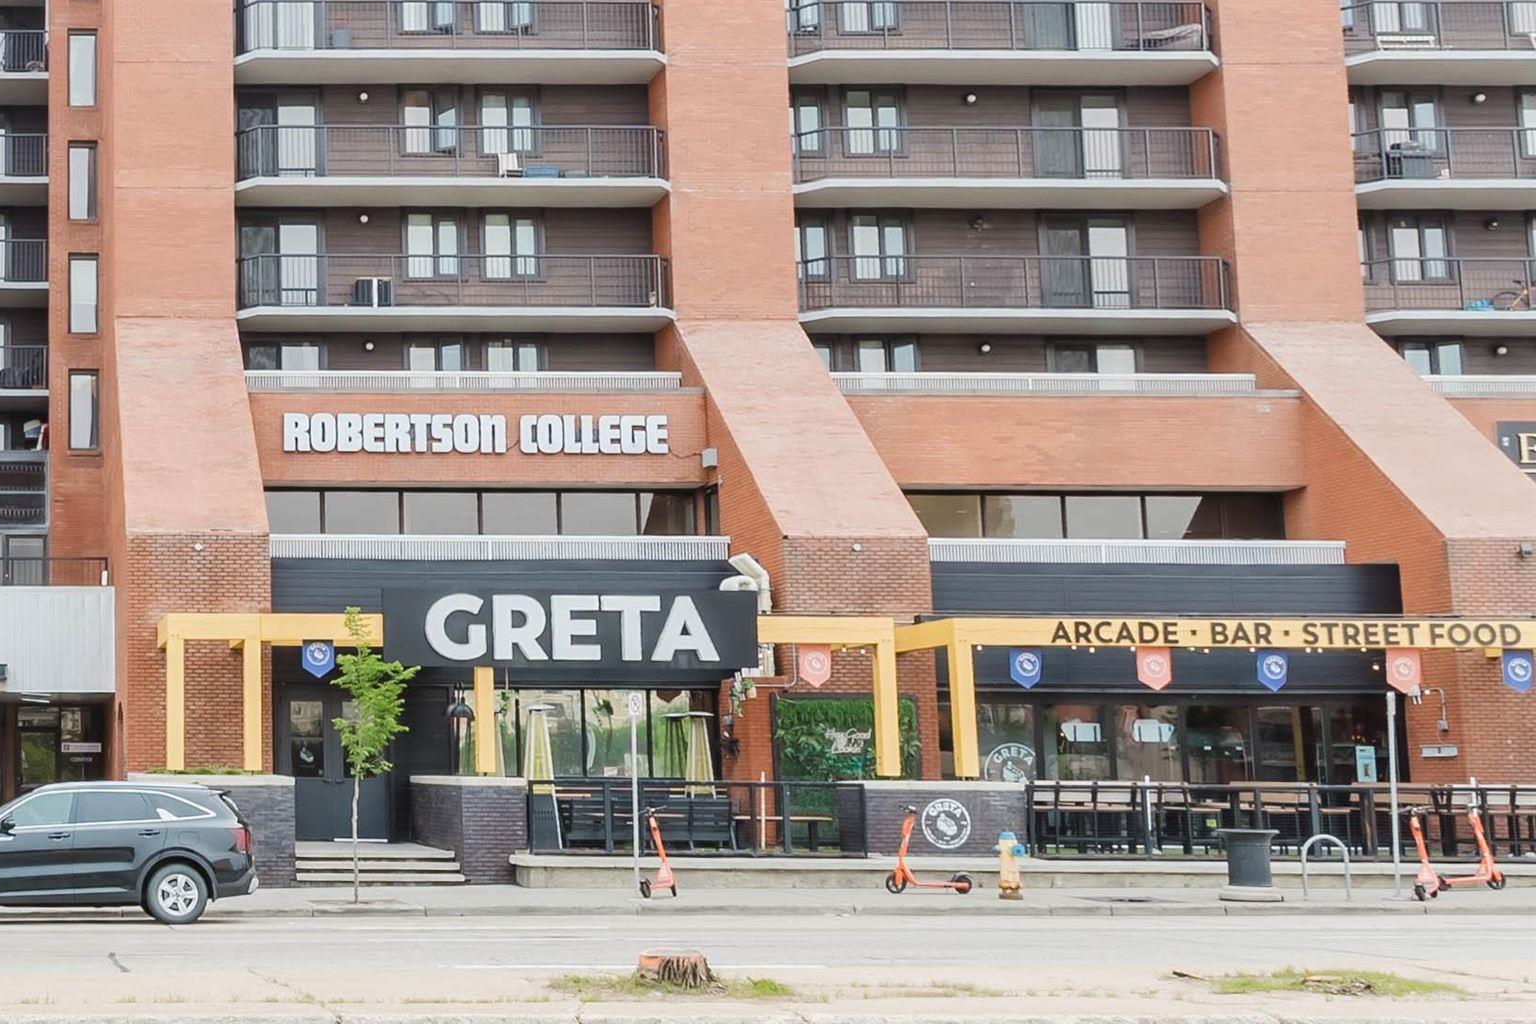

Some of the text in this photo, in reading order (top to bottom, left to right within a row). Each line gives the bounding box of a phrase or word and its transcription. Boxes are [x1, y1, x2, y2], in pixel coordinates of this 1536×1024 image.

[282, 413, 669, 454] ROBERTSON COLLEGE
[424, 593, 721, 662] GRETA
[1051, 621, 1521, 646] ARCADE BAR STREET FOOD
[993, 747, 1034, 766] GRETA
[928, 802, 962, 818] GRETA
